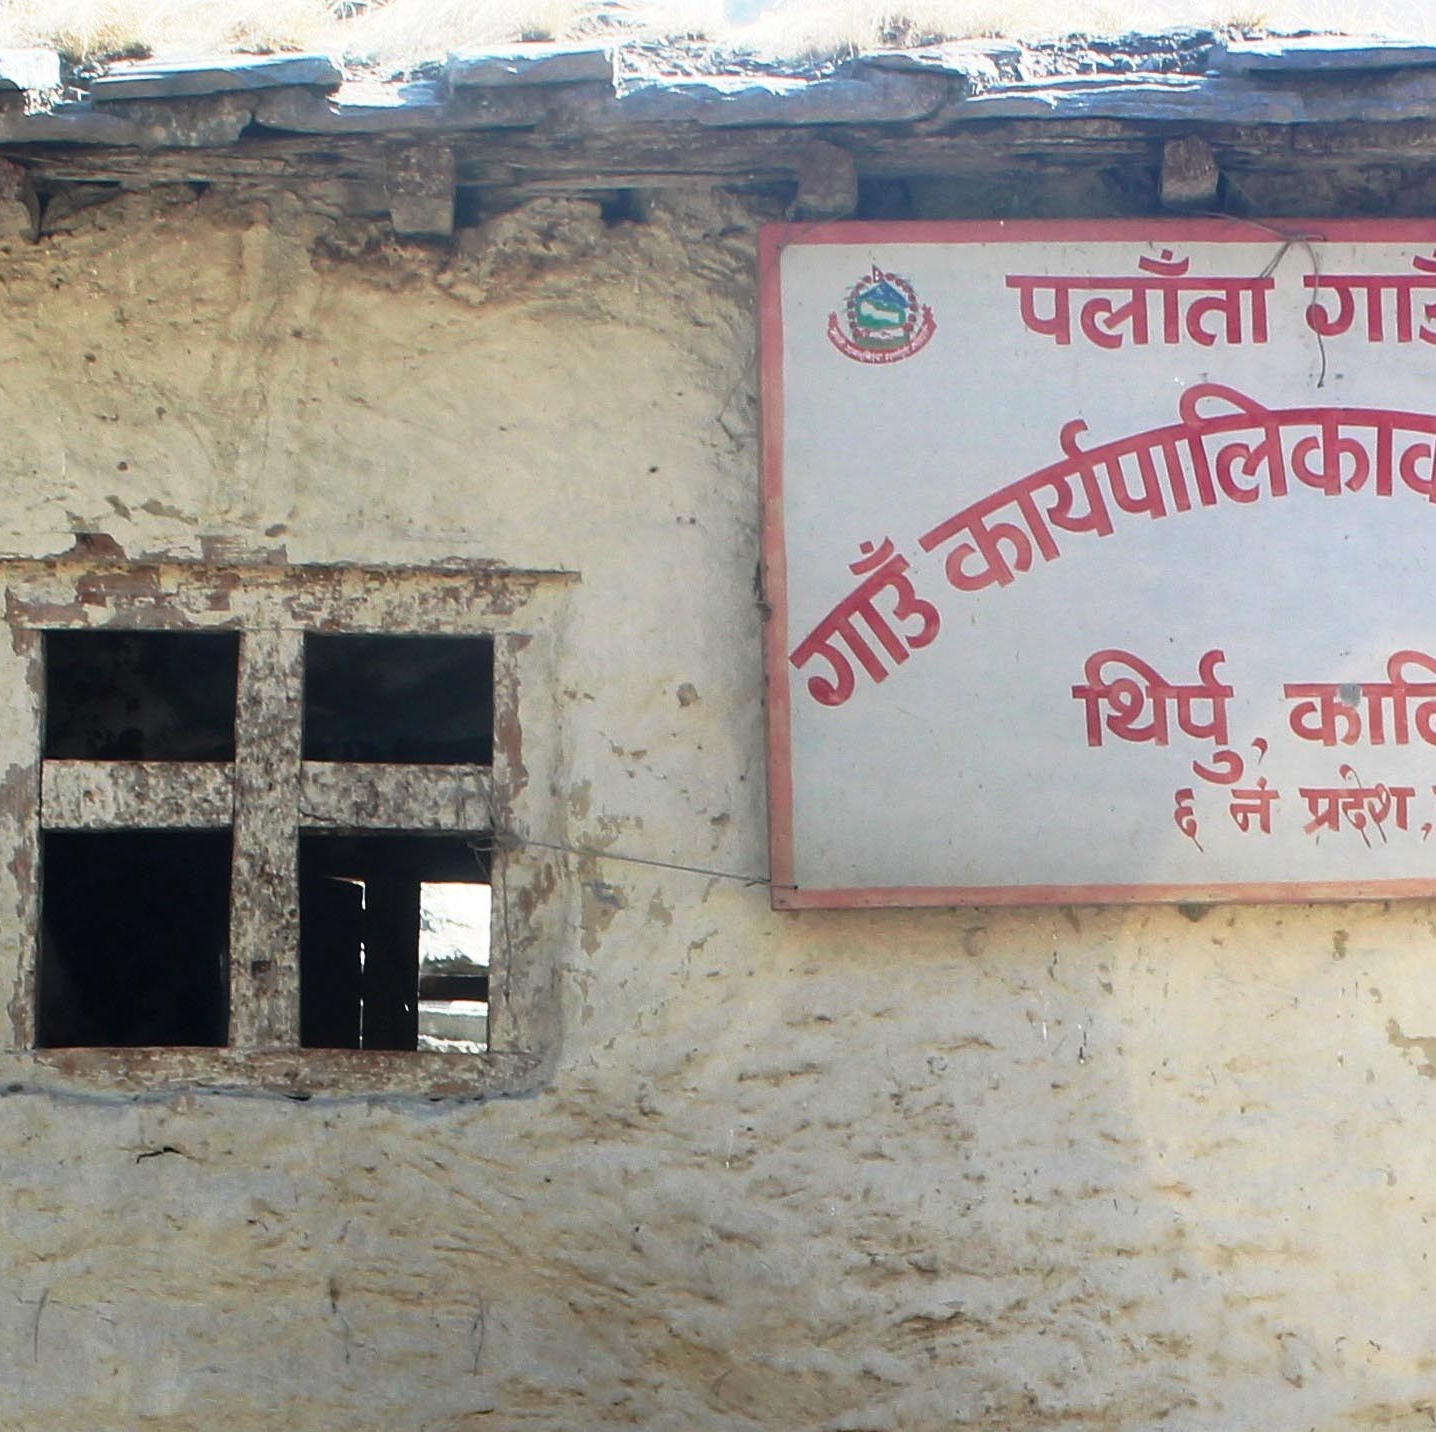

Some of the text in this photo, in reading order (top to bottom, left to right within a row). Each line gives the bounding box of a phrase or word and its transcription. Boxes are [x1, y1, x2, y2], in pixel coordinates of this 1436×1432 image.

[1005, 249, 1276, 348] पलाँता
[789, 536, 941, 707] गाउँ
[1174, 788, 1205, 852] ६
